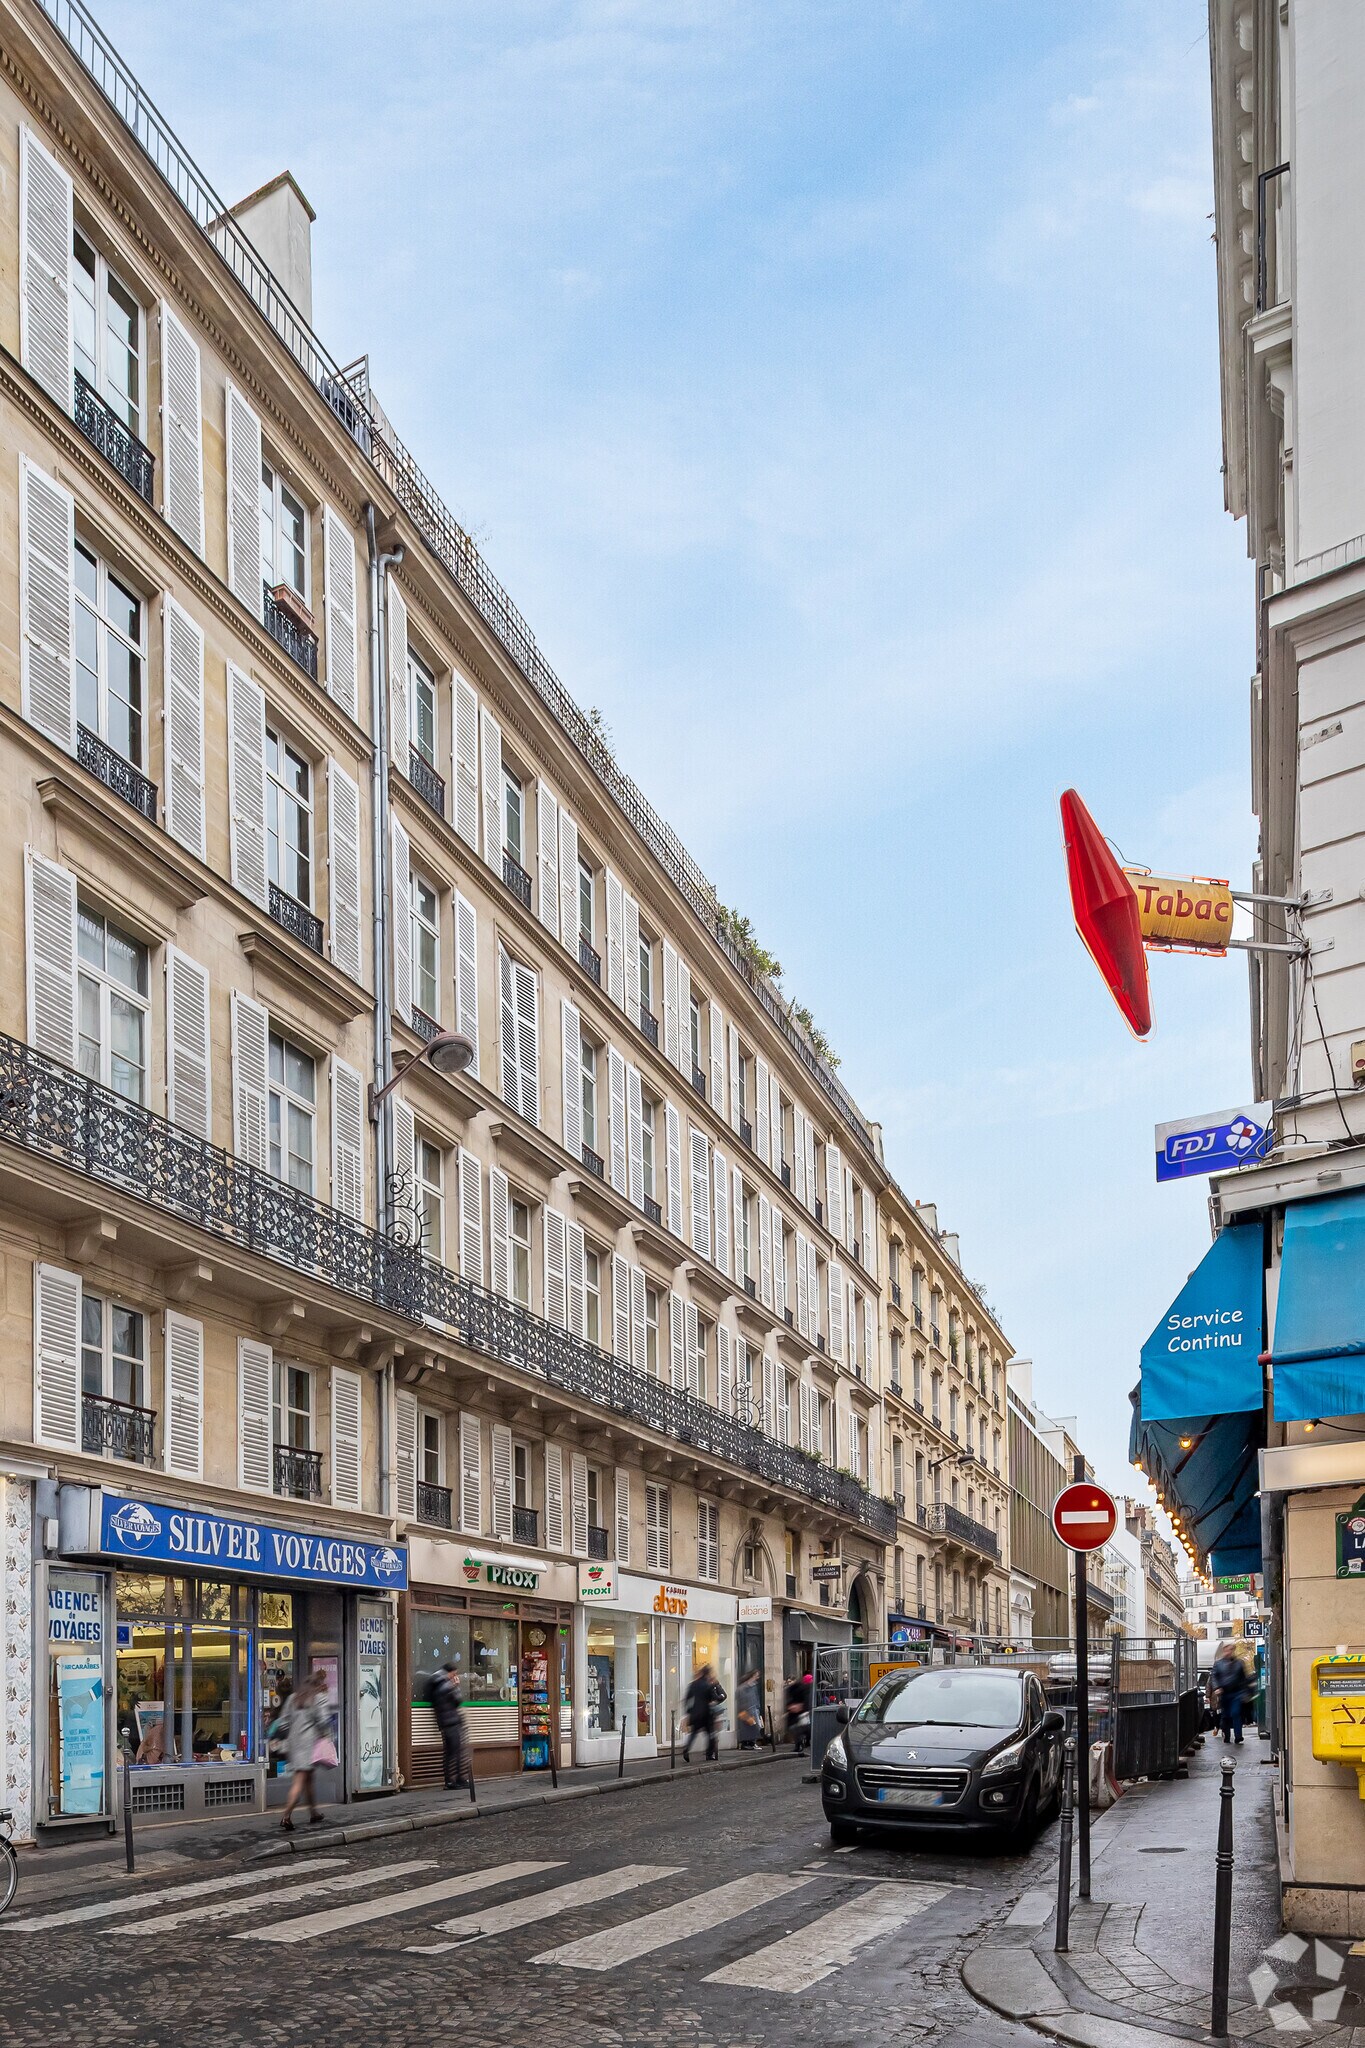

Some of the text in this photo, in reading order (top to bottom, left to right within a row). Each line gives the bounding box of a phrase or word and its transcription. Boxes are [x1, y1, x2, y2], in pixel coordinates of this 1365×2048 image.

[1137, 884, 1230, 923] Tabac
[1170, 1132, 1216, 1158] FDJ
[1167, 1308, 1244, 1331] Service
[1167, 1332, 1242, 1353] Continu
[110, 1515, 160, 1534] SILVER VOYAGES
[169, 1514, 367, 1577] SILVER VOYAGES
[491, 1565, 540, 1589] PROXI
[653, 1584, 688, 1616] albane
[740, 1604, 769, 1616] albane
[360, 1617, 384, 1633] GENCE
[359, 1639, 386, 1655] OYAGES
